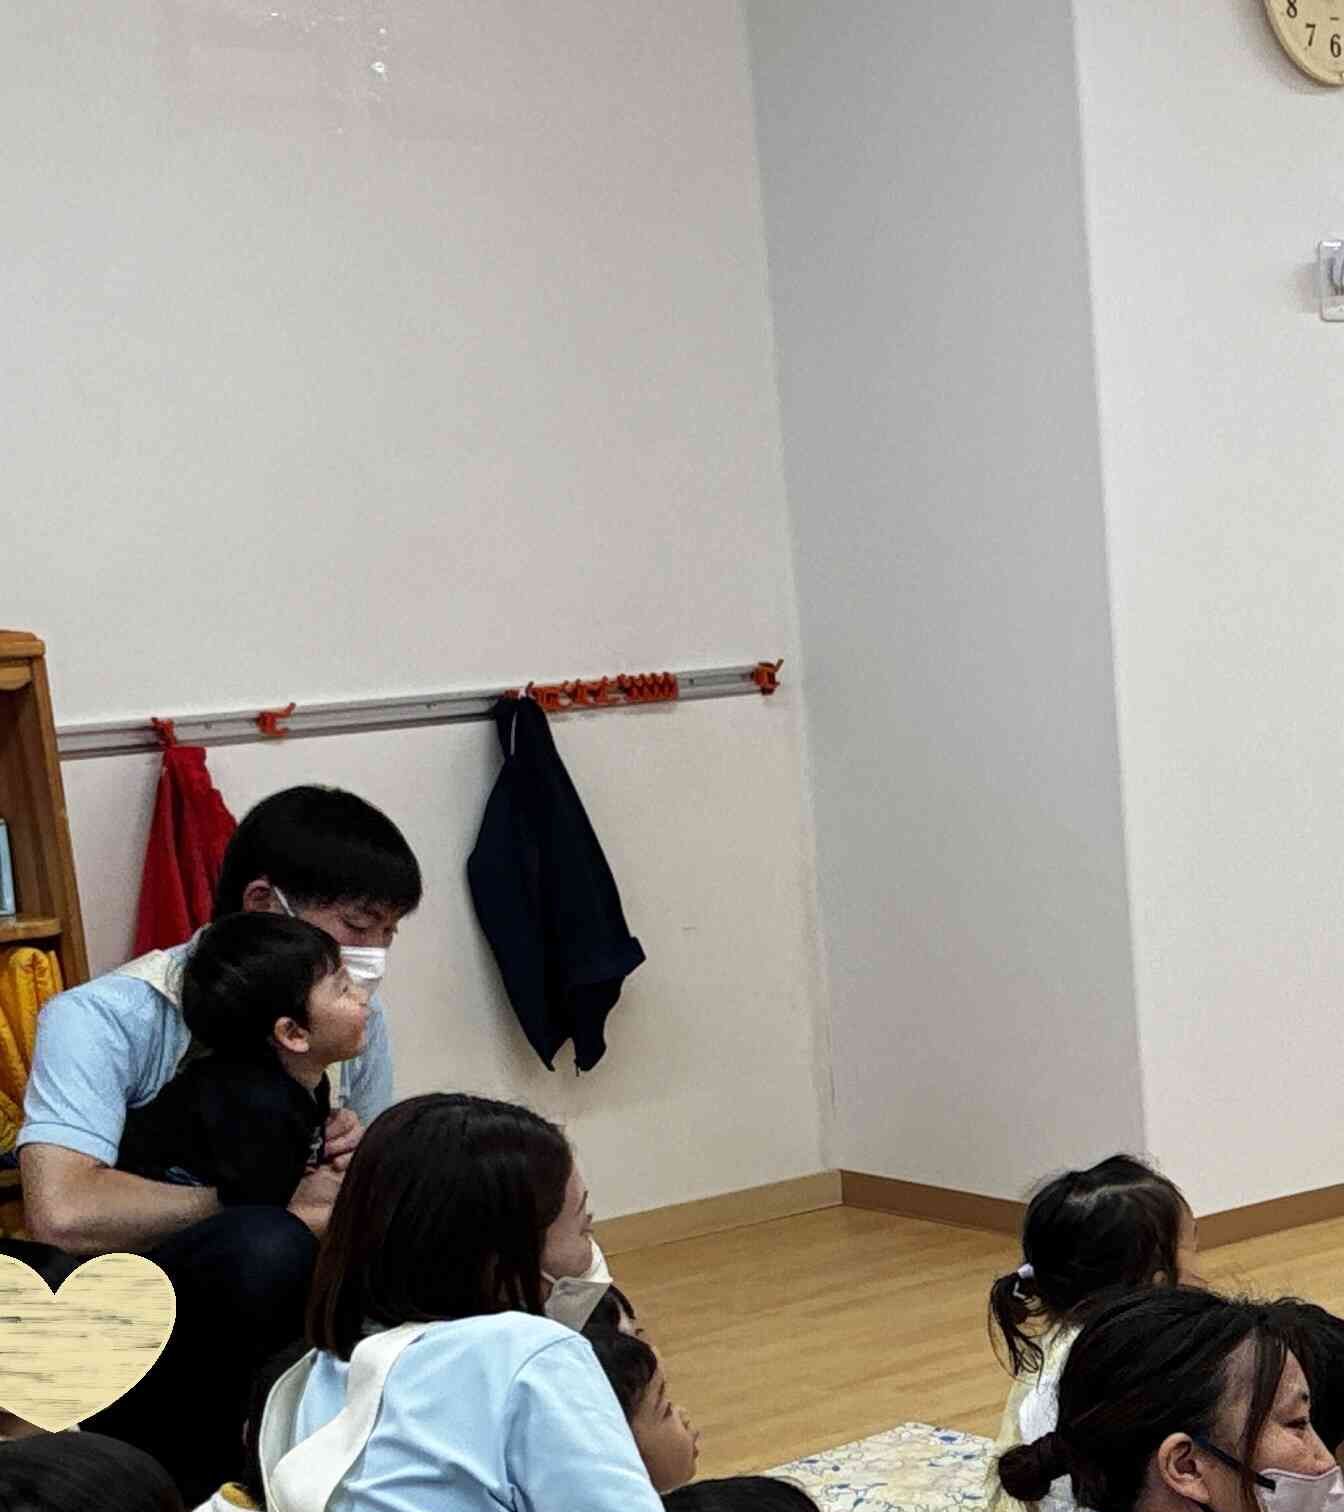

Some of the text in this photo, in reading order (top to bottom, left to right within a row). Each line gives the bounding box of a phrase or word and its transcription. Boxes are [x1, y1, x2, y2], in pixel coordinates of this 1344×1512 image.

[1286, 0, 1298, 18] 8
[1305, 23, 1316, 47] 7
[1330, 33, 1342, 58] 6
